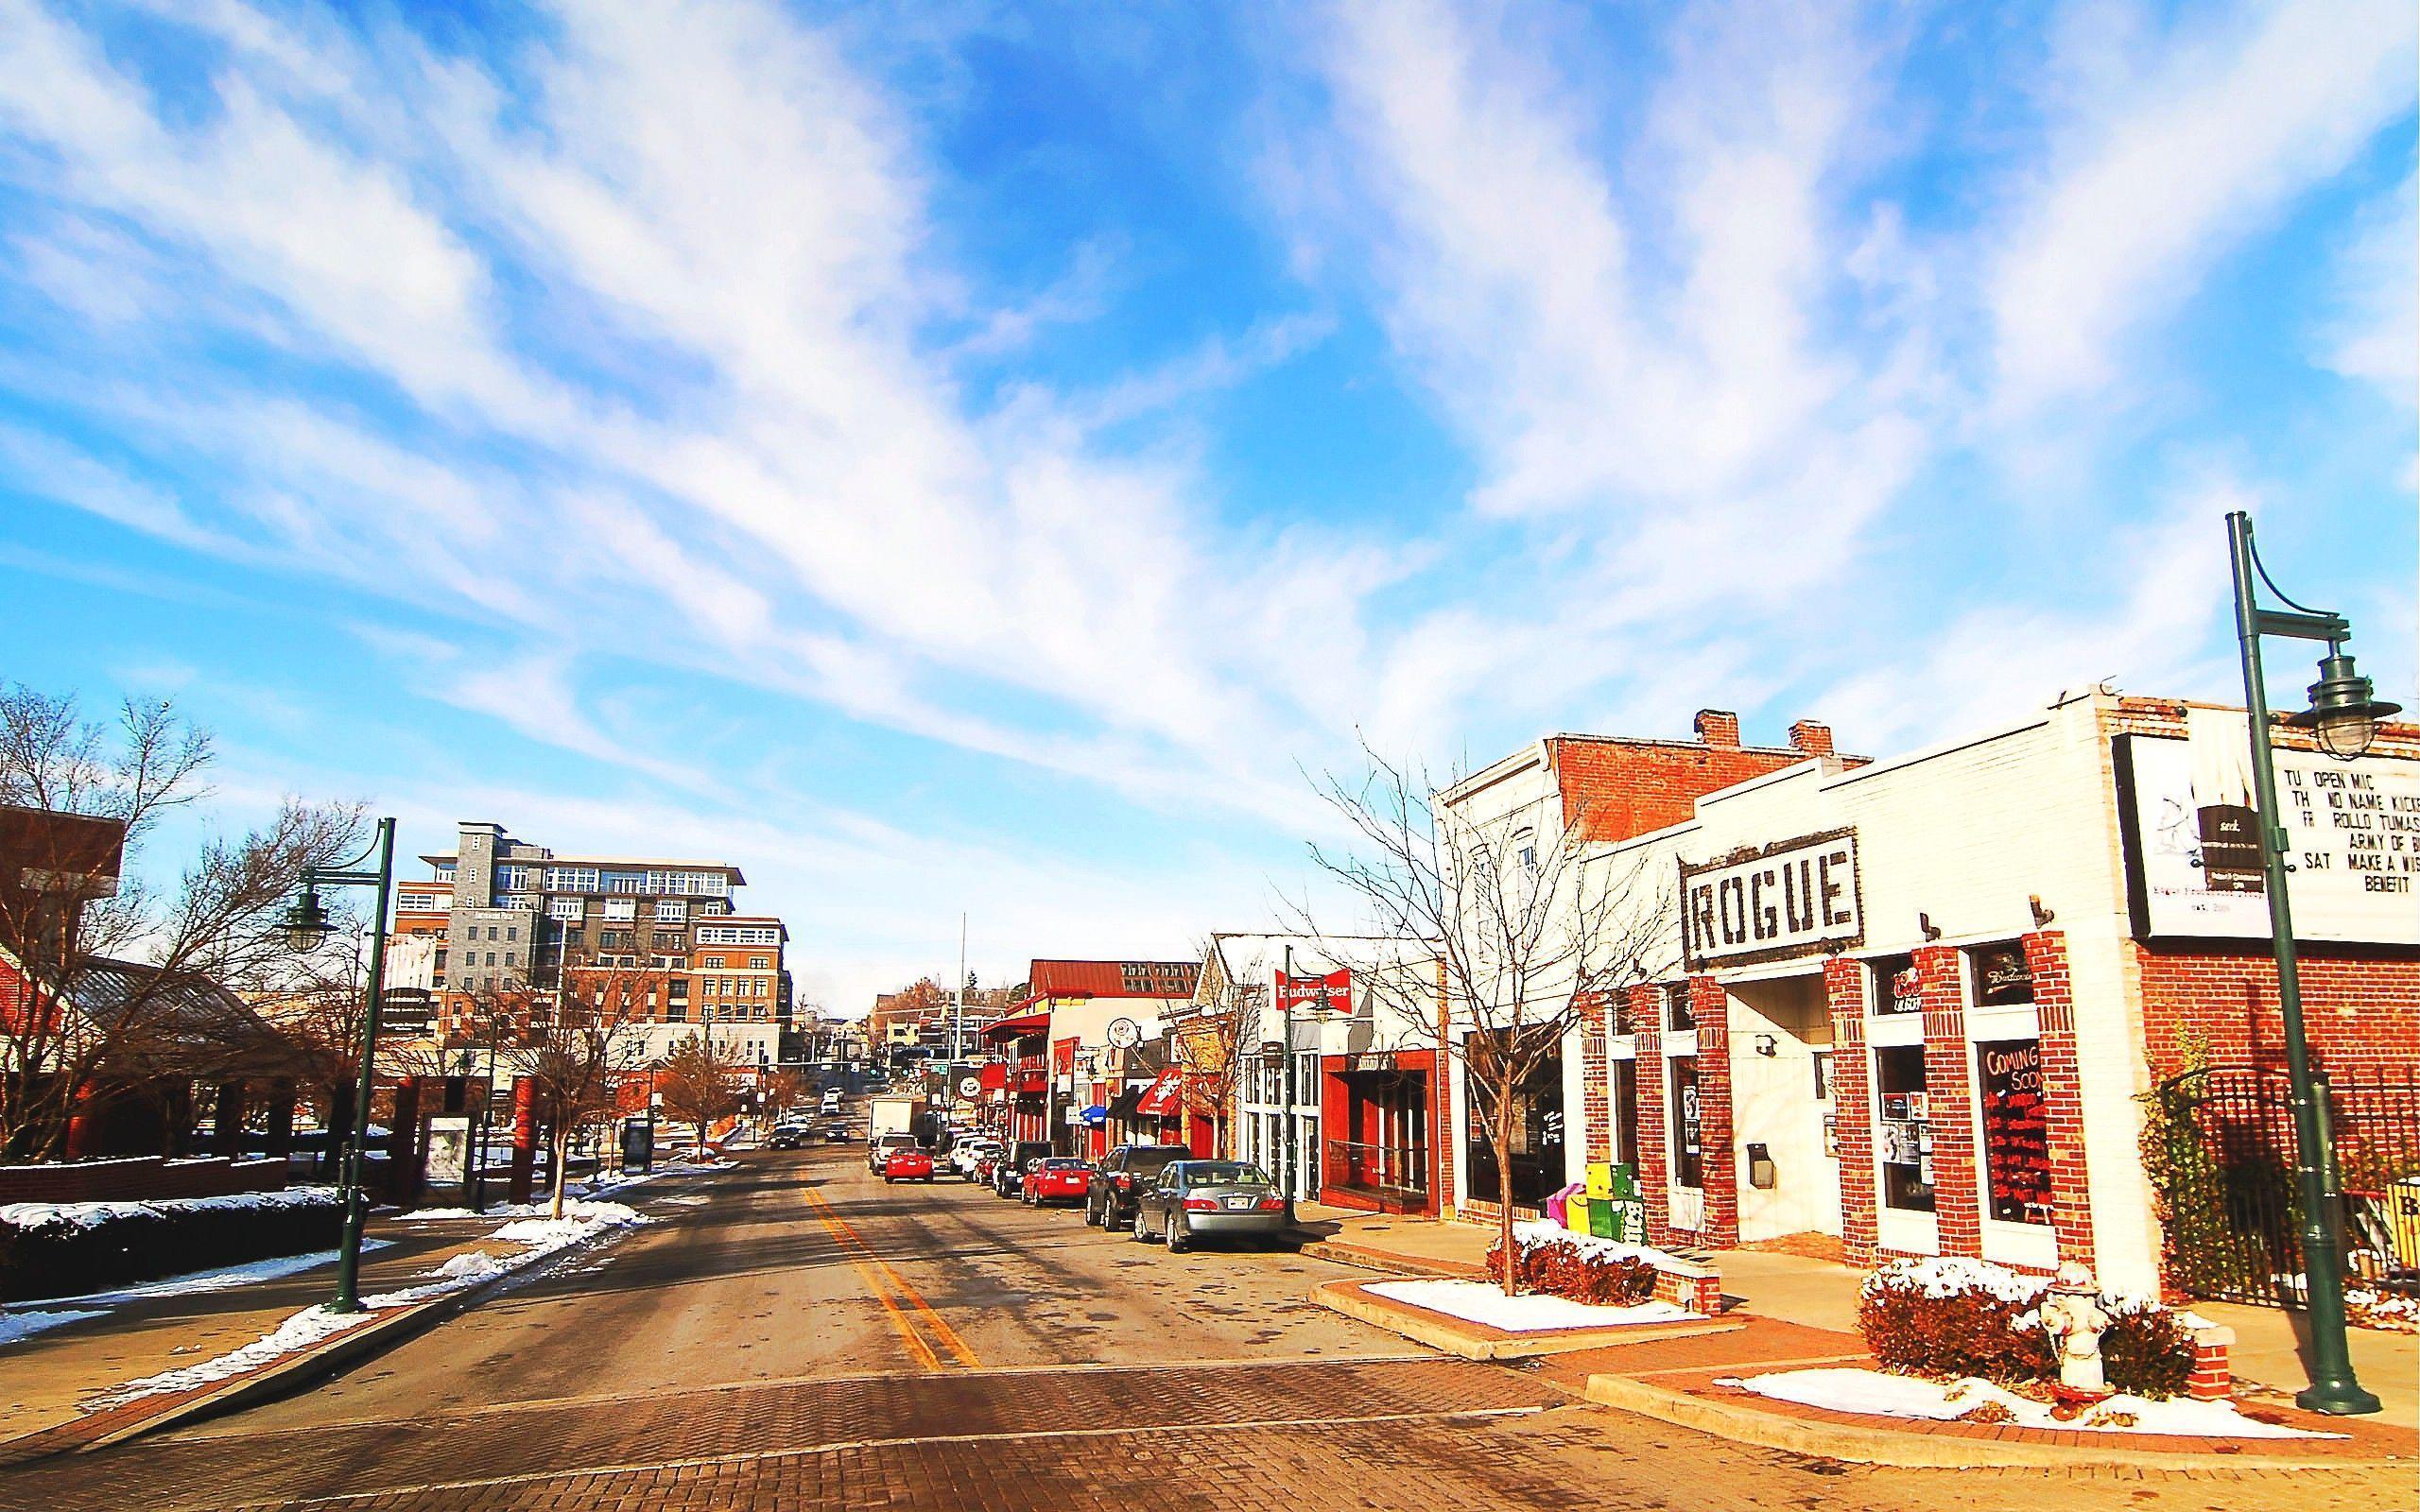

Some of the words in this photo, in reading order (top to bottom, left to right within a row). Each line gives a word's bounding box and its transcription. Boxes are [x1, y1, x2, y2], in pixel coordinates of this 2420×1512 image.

[2284, 769, 2301, 786] TU
[2314, 772, 2345, 788] OPEN
[2351, 773, 2375, 790] MIC
[2292, 790, 2309, 807] TH
[2327, 792, 2342, 808] NO
[2349, 794, 2384, 810] NAME
[2333, 813, 2371, 829] ROLLO
[2350, 833, 2384, 850] ARMY
[2391, 835, 2404, 850] OF
[2305, 852, 2330, 868] SAT
[2348, 853, 2382, 870] MAKE
[2387, 855, 2395, 870] A
[2364, 875, 2410, 893] BENEFIT
[1691, 851, 1851, 951] ROGUE
[1277, 984, 1350, 999] Budwser
[1986, 1045, 2039, 1076] COMING
